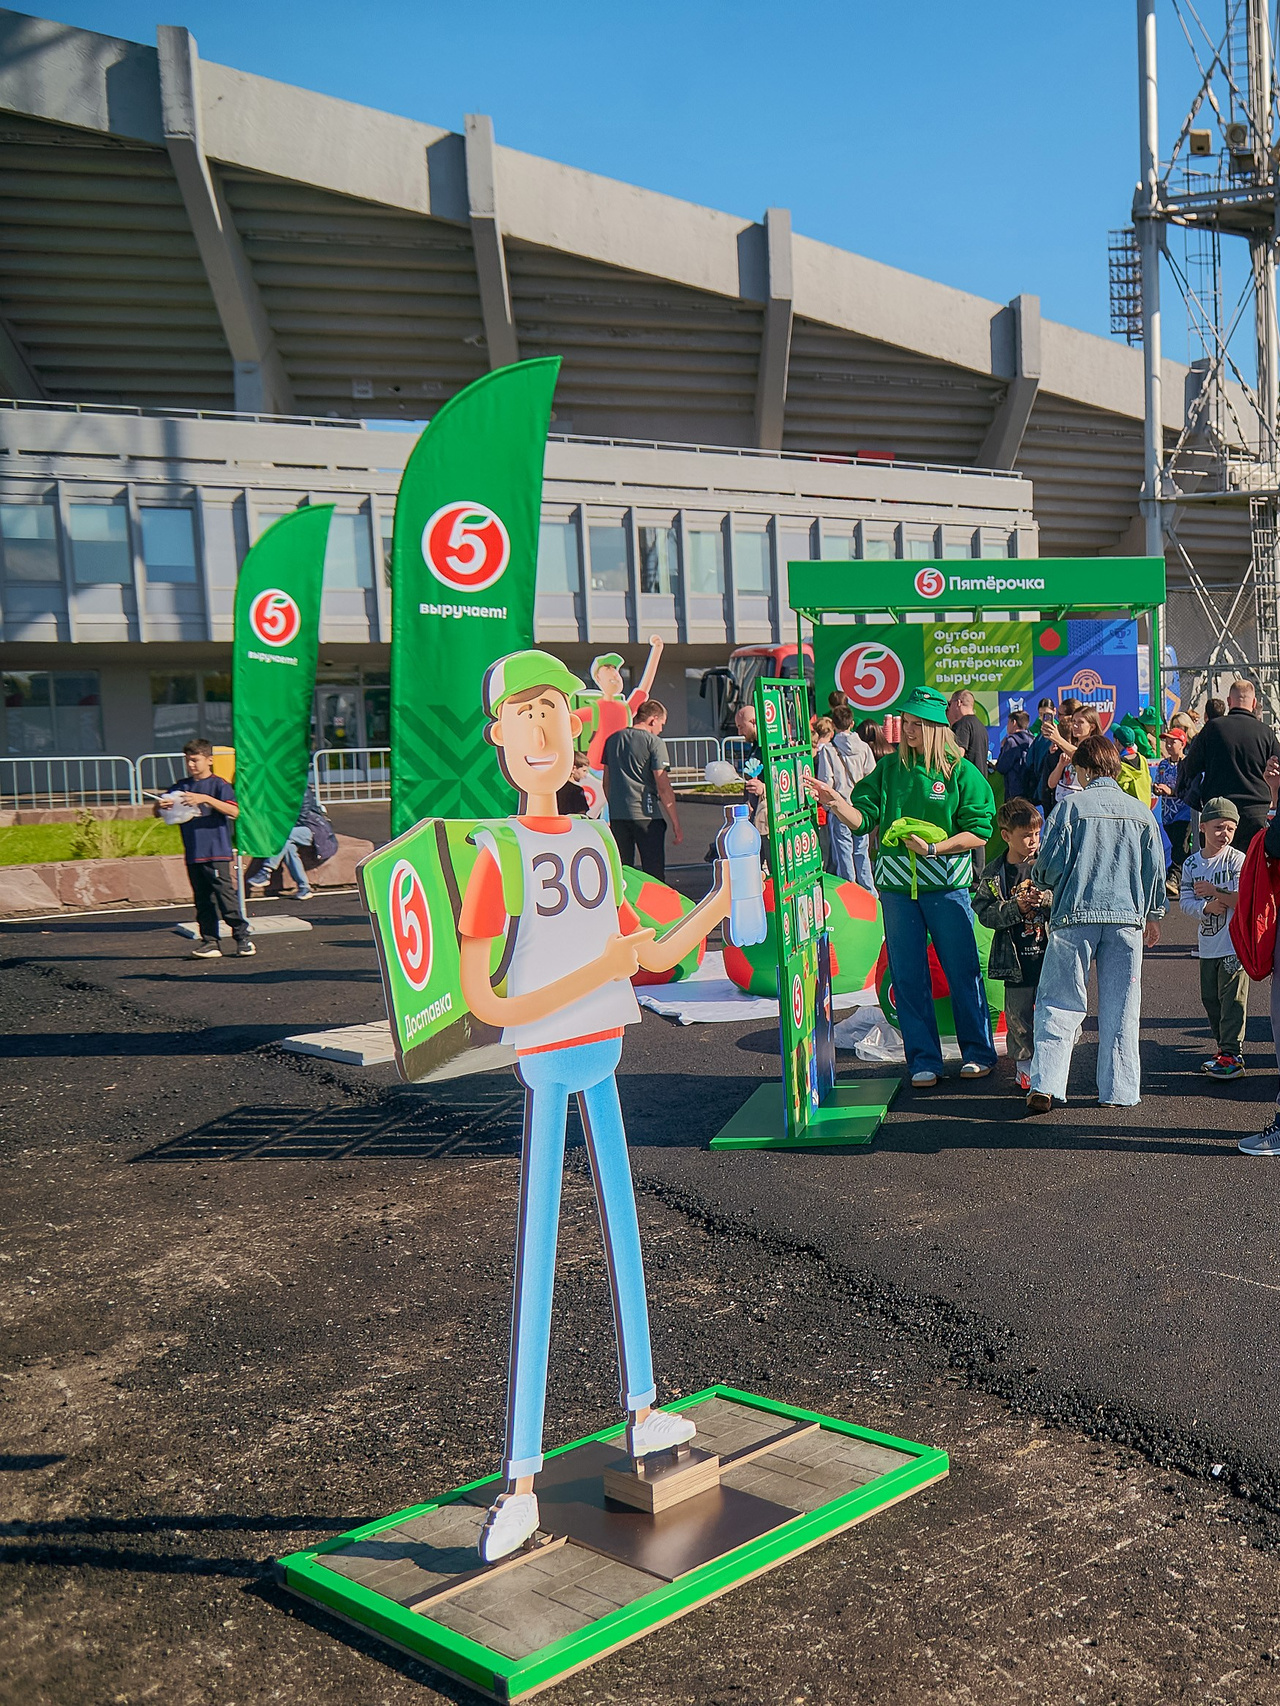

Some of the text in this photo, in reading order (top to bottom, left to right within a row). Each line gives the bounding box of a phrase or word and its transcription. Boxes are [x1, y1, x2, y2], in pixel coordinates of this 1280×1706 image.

[949, 576, 1045, 593] Пятёрочка
[418, 603, 508, 619] выручает!
[934, 629, 986, 643] Футбол
[935, 643, 1020, 655] объединяет!
[247, 651, 298, 666] выручает!
[935, 657, 1023, 670] «Пятёрочка»
[936, 673, 1003, 685] выручает
[531, 847, 608, 917] 30
[404, 992, 453, 1042] Доставка
